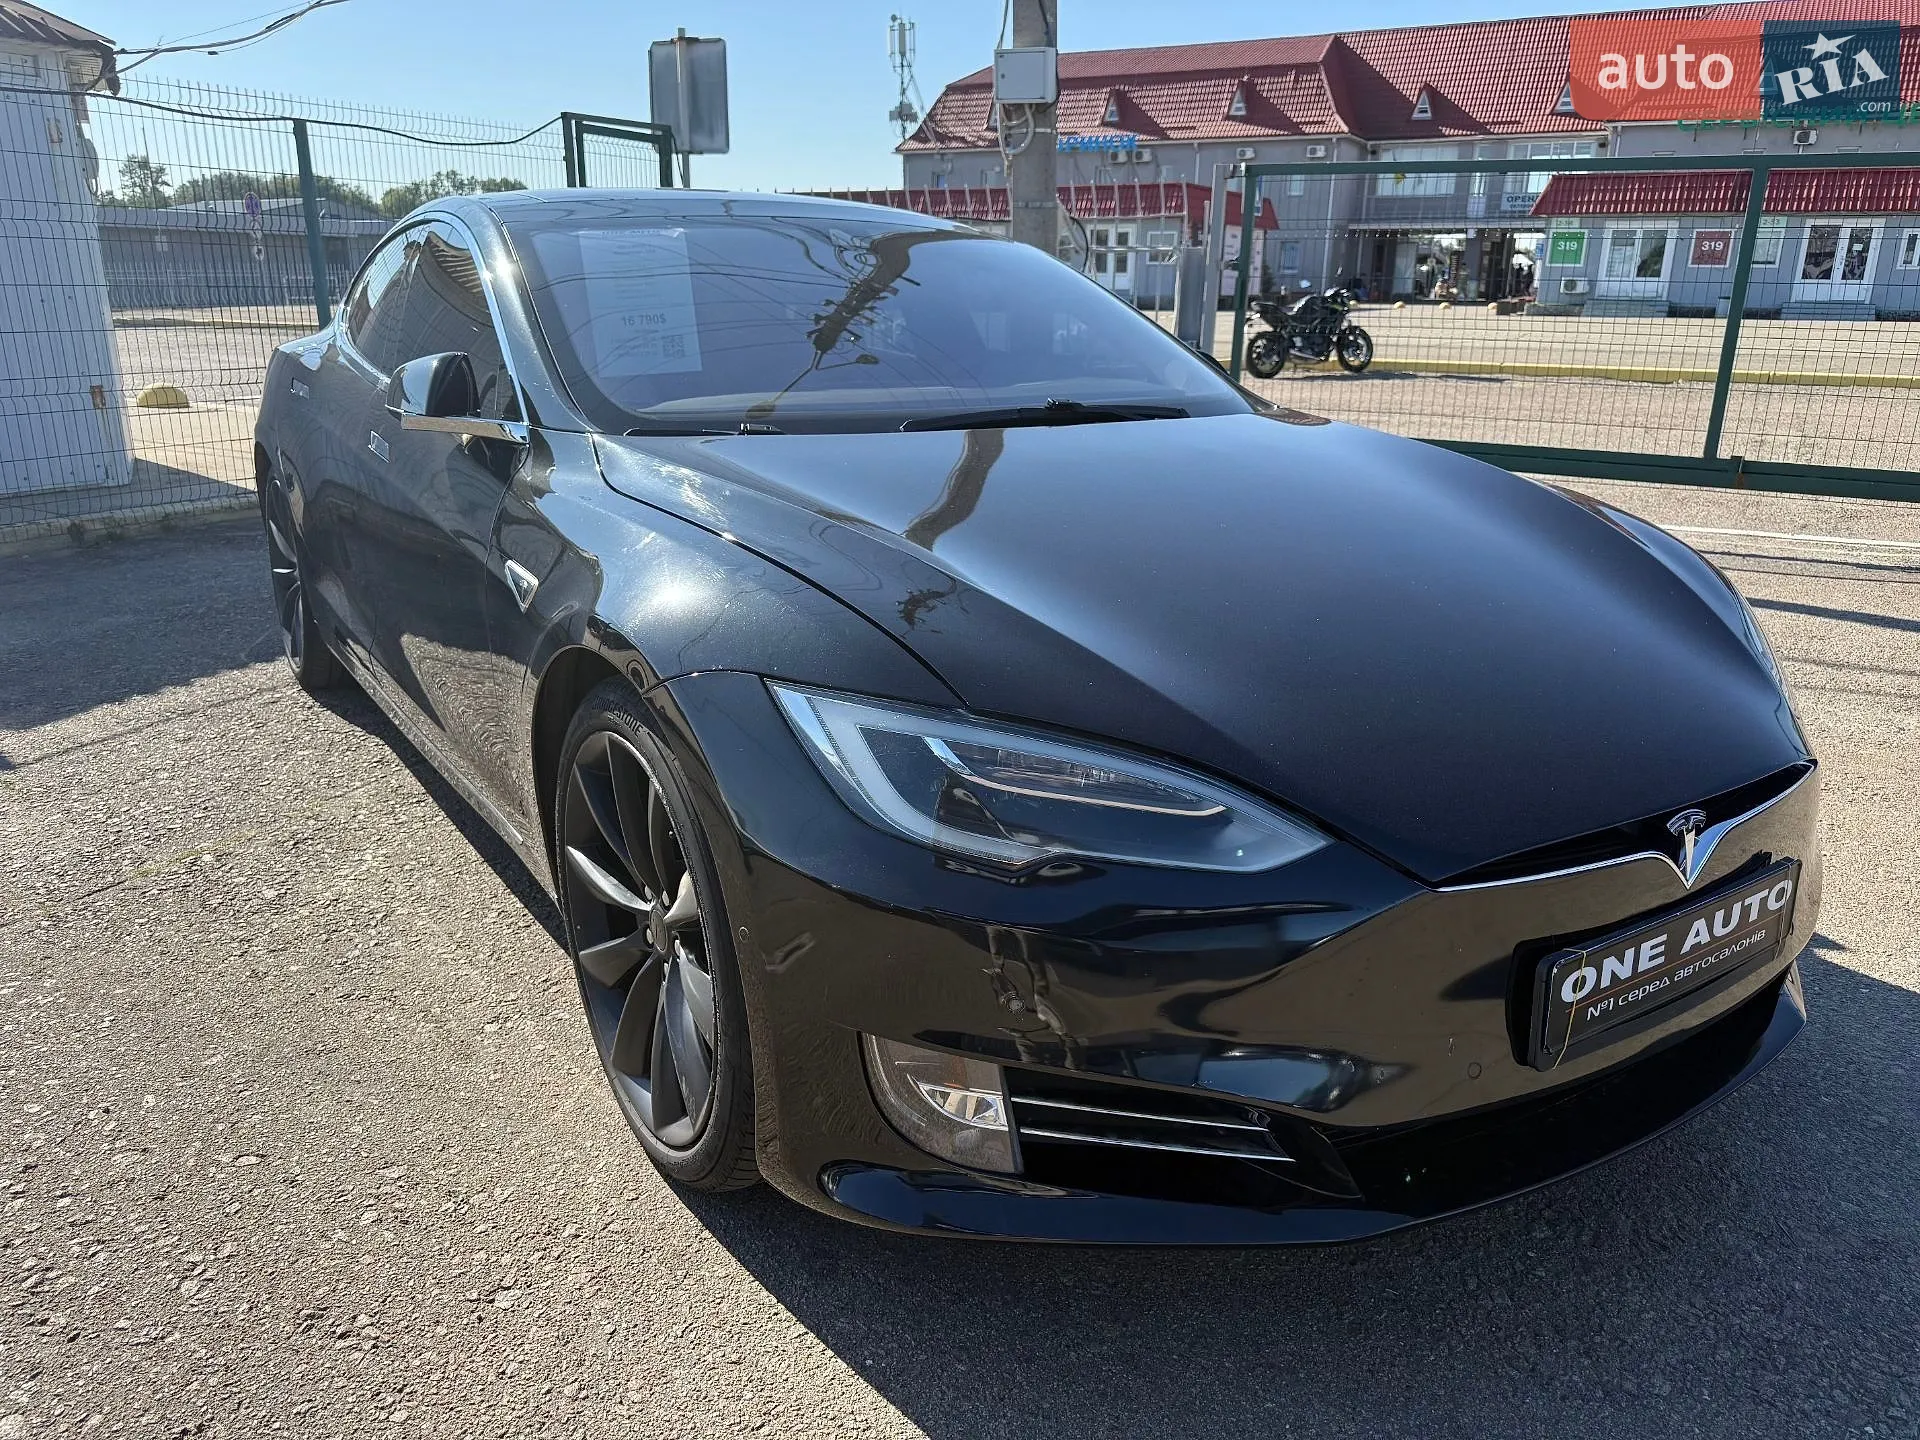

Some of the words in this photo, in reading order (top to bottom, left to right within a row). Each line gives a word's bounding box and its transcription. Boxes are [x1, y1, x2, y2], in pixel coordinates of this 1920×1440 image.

[1557, 241, 1578, 250] 319
[1701, 241, 1724, 251] 319
[1561, 933, 1668, 1003] ONE
[1680, 879, 1793, 954] AUTO
[1618, 975, 1671, 1006] серед
[1674, 929, 1767, 981] автосалонів
